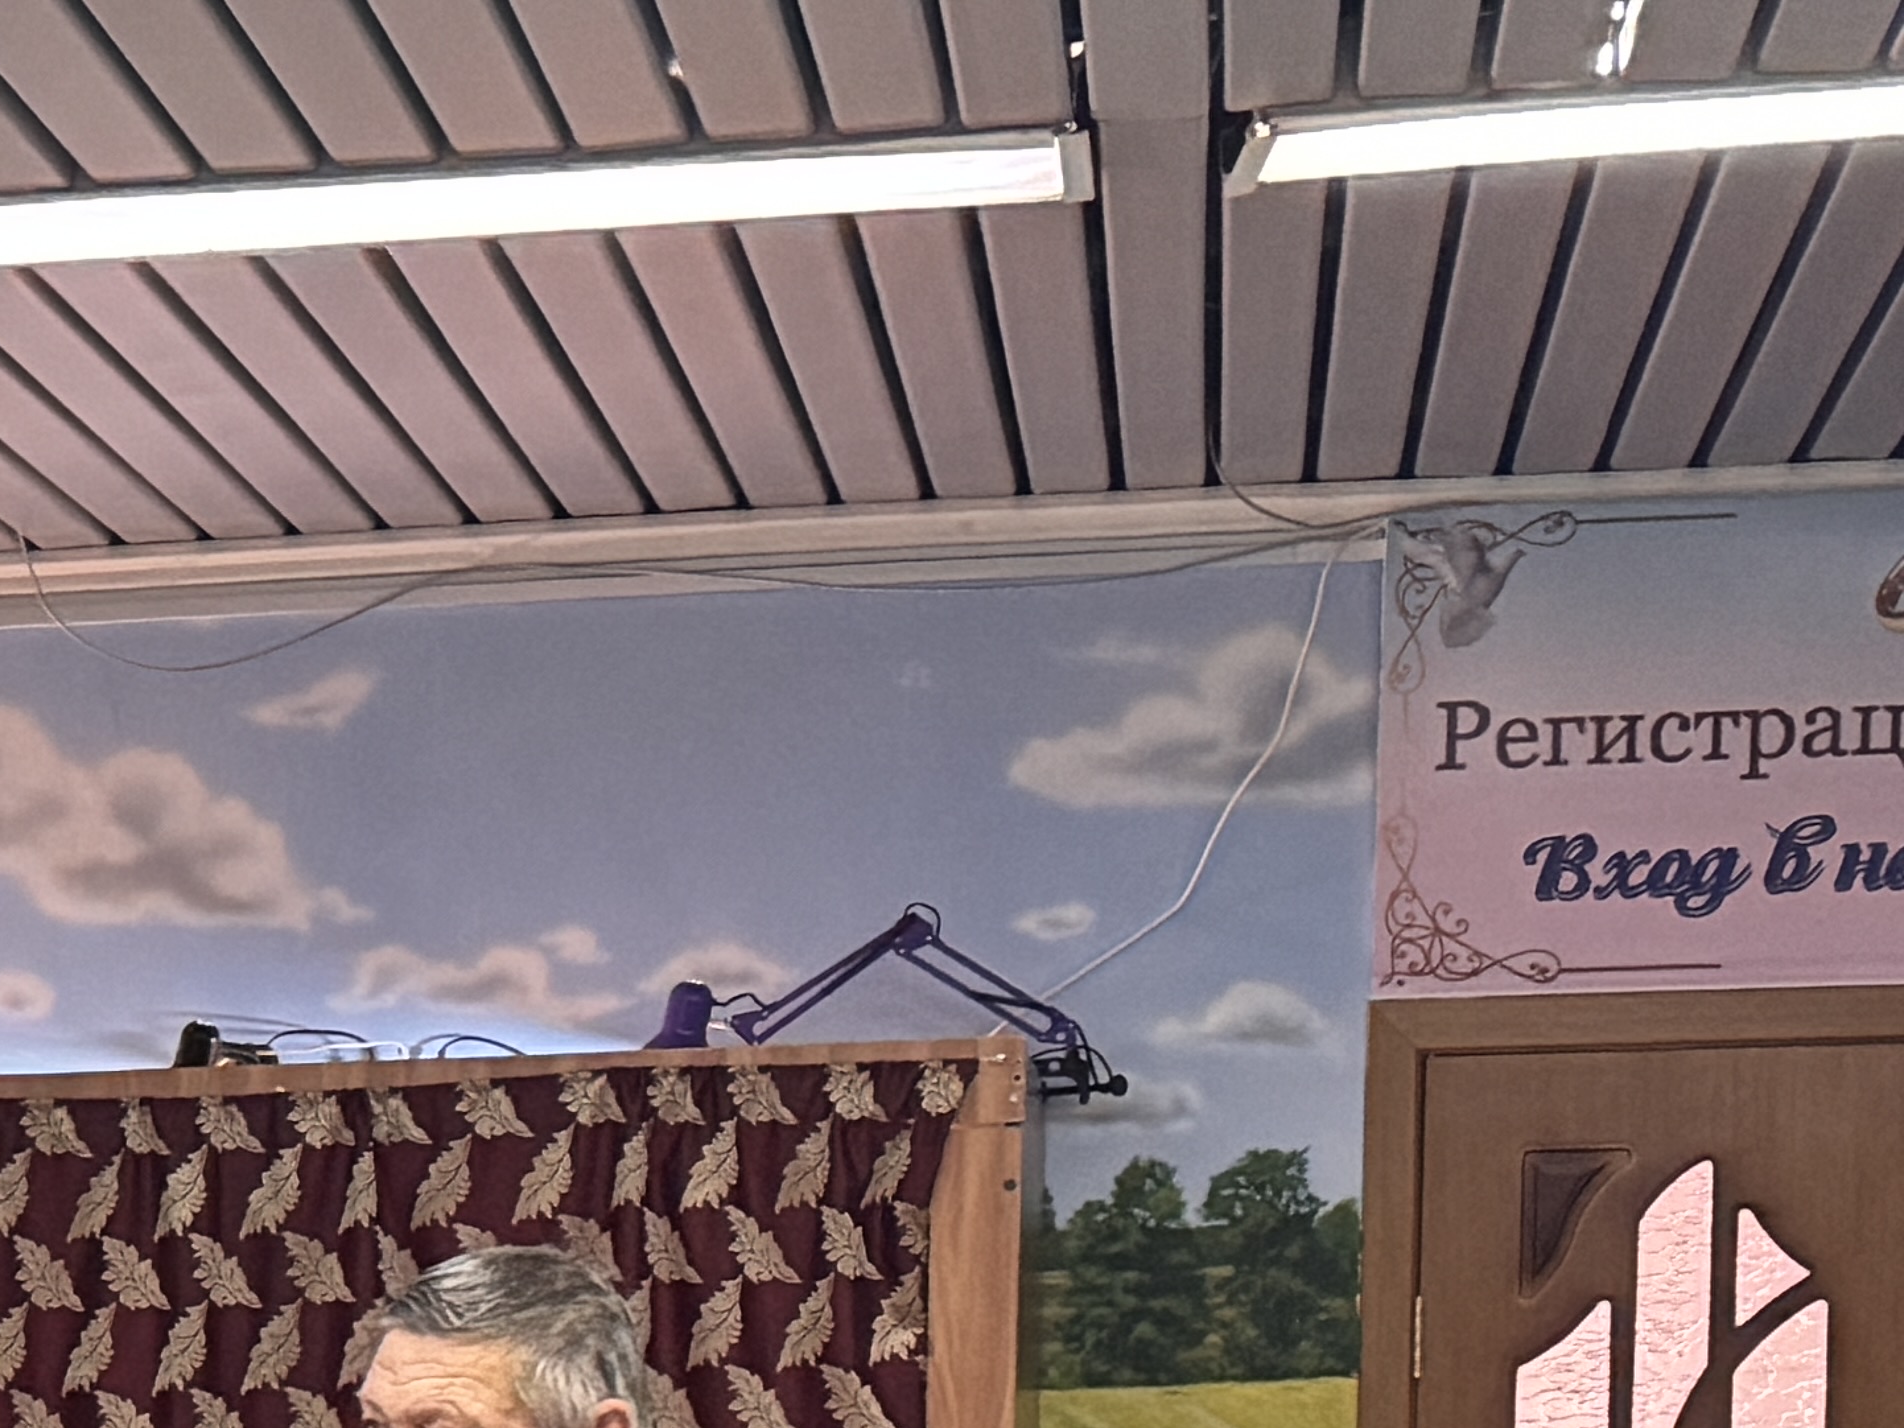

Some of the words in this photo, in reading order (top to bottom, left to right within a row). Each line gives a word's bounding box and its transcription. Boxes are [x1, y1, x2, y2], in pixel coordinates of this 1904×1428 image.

[1435, 700, 1904, 779] Регистрац
[1523, 832, 1752, 918] Вход
[1765, 814, 1837, 895] в
